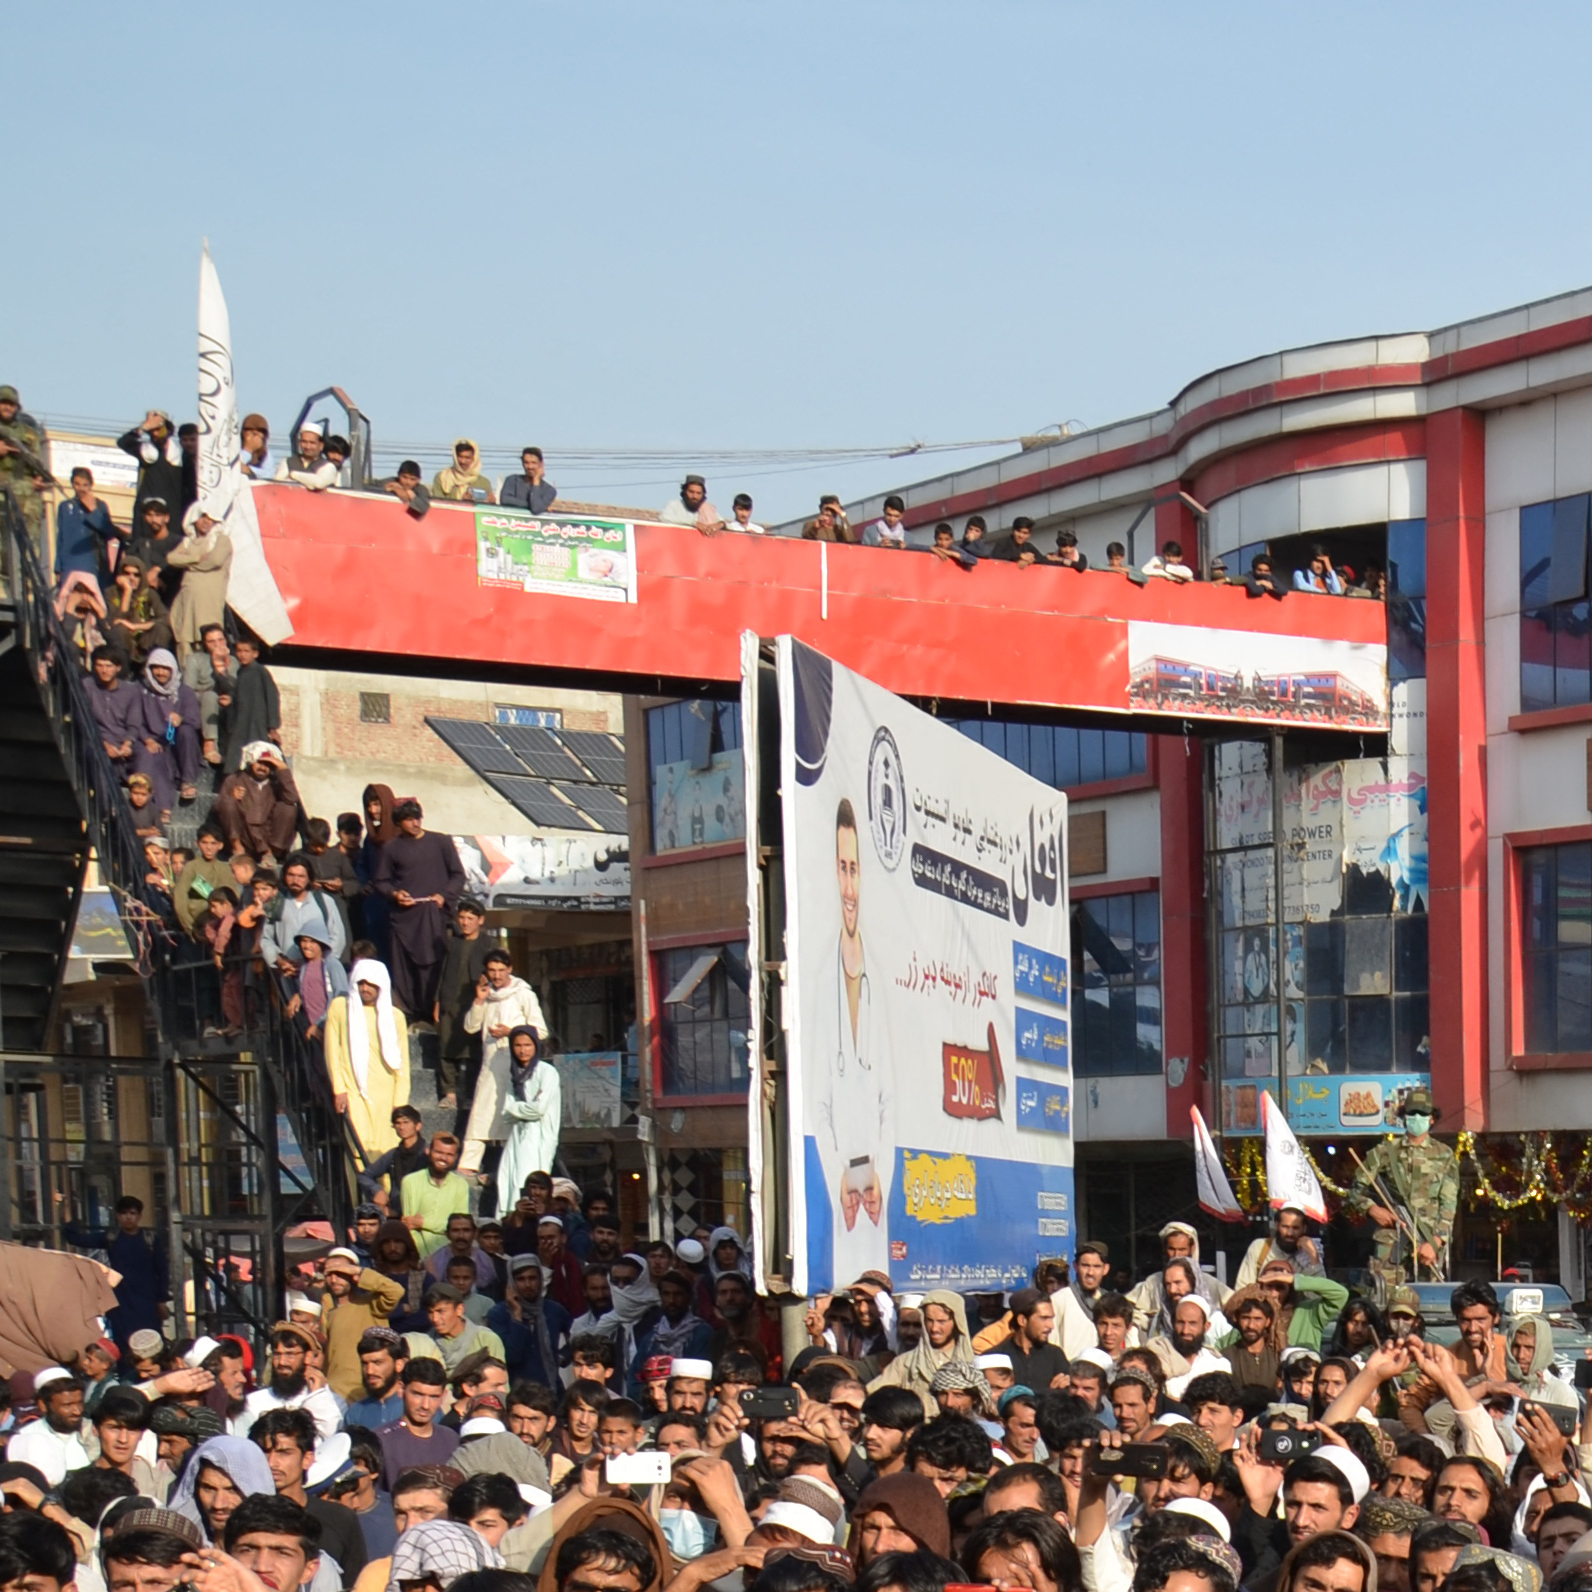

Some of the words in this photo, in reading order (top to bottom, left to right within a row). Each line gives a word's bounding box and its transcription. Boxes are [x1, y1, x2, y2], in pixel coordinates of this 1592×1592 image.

[1292, 824, 1333, 840] POWER
[1011, 802, 1065, 927] افغان
[950, 1055, 980, 1107] 50%
